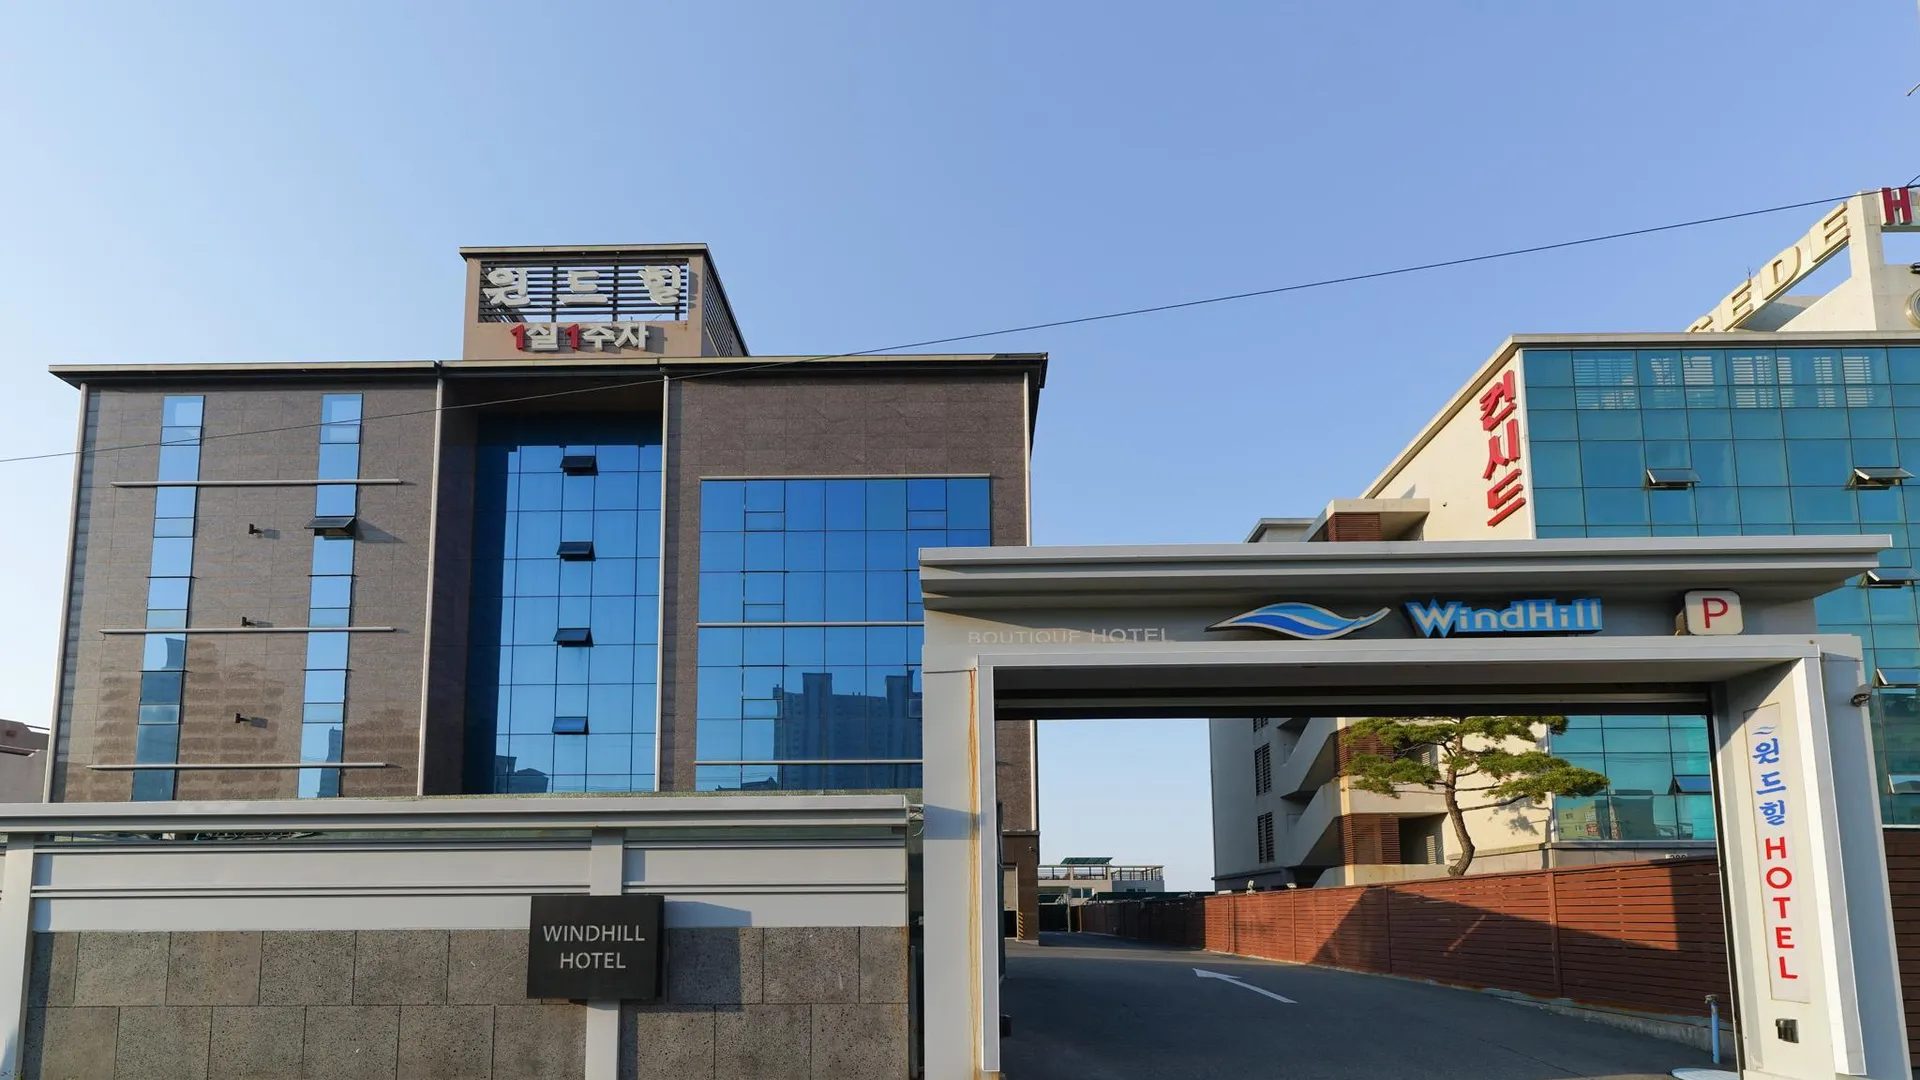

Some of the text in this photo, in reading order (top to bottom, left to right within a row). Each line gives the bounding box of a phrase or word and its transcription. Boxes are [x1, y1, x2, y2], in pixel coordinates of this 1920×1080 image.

[1479, 369, 1526, 528] 컨시드
[1405, 597, 1603, 637] WindHill
[1702, 597, 1728, 629] P
[1765, 836, 1798, 980] HOTEL
[543, 925, 645, 942] WINDHILL
[560, 952, 626, 969] HOTEL
